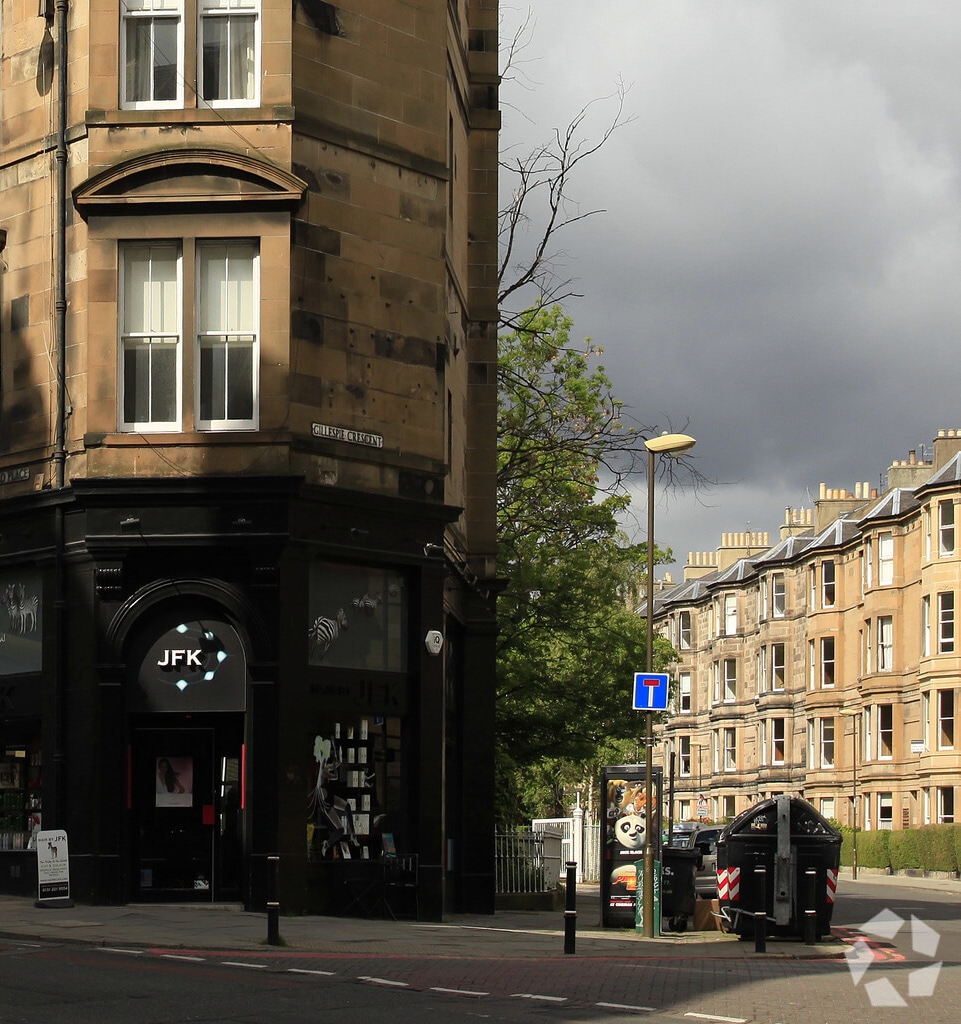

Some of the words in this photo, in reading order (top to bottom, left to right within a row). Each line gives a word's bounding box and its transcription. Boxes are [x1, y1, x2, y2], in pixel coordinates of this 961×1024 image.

[314, 424, 344, 440] GILLESPIE
[347, 431, 381, 447] CRESCENT
[8, 467, 29, 481] PLACE
[157, 649, 202, 666] JFK
